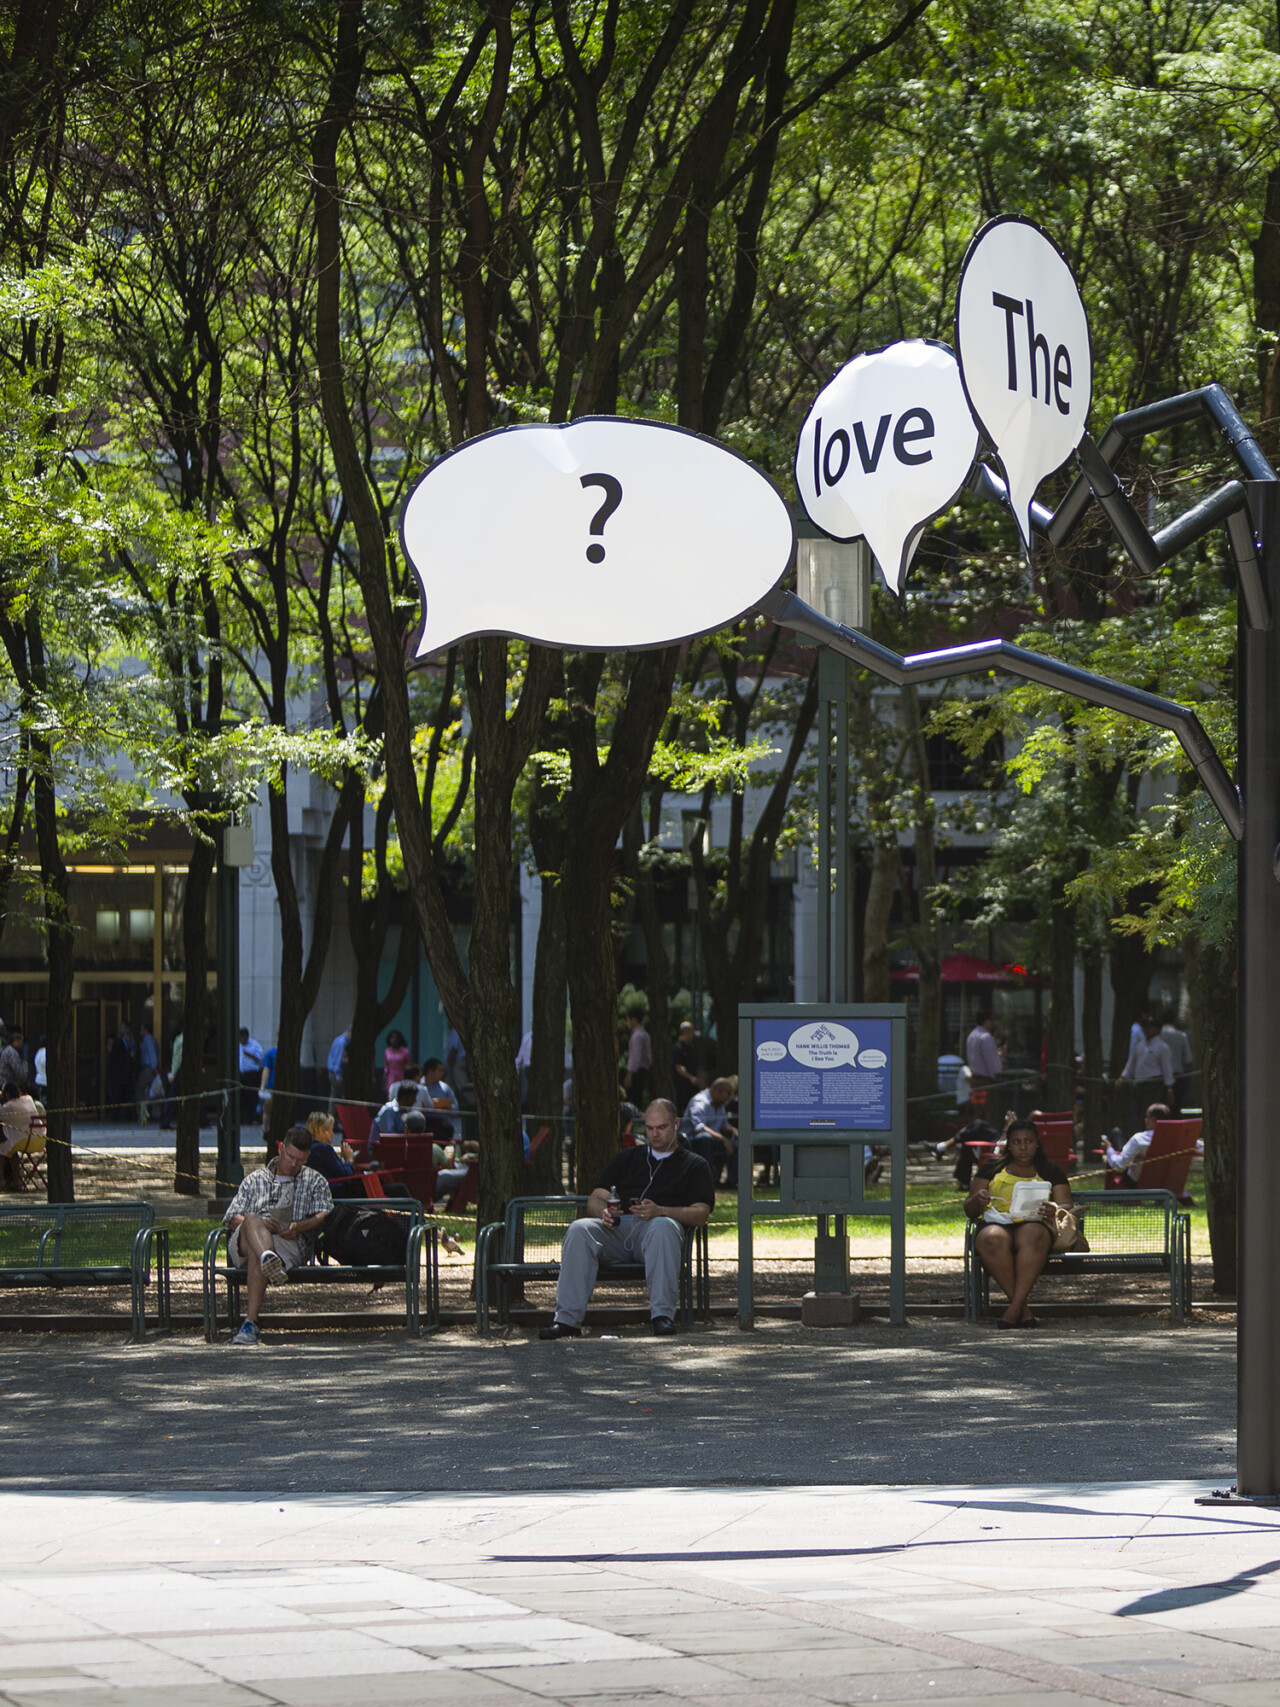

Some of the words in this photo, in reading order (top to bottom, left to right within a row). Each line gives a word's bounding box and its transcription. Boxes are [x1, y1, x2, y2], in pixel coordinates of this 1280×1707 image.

[992, 291, 1073, 415] The
[813, 407, 935, 497] love
[580, 472, 623, 564] ?
